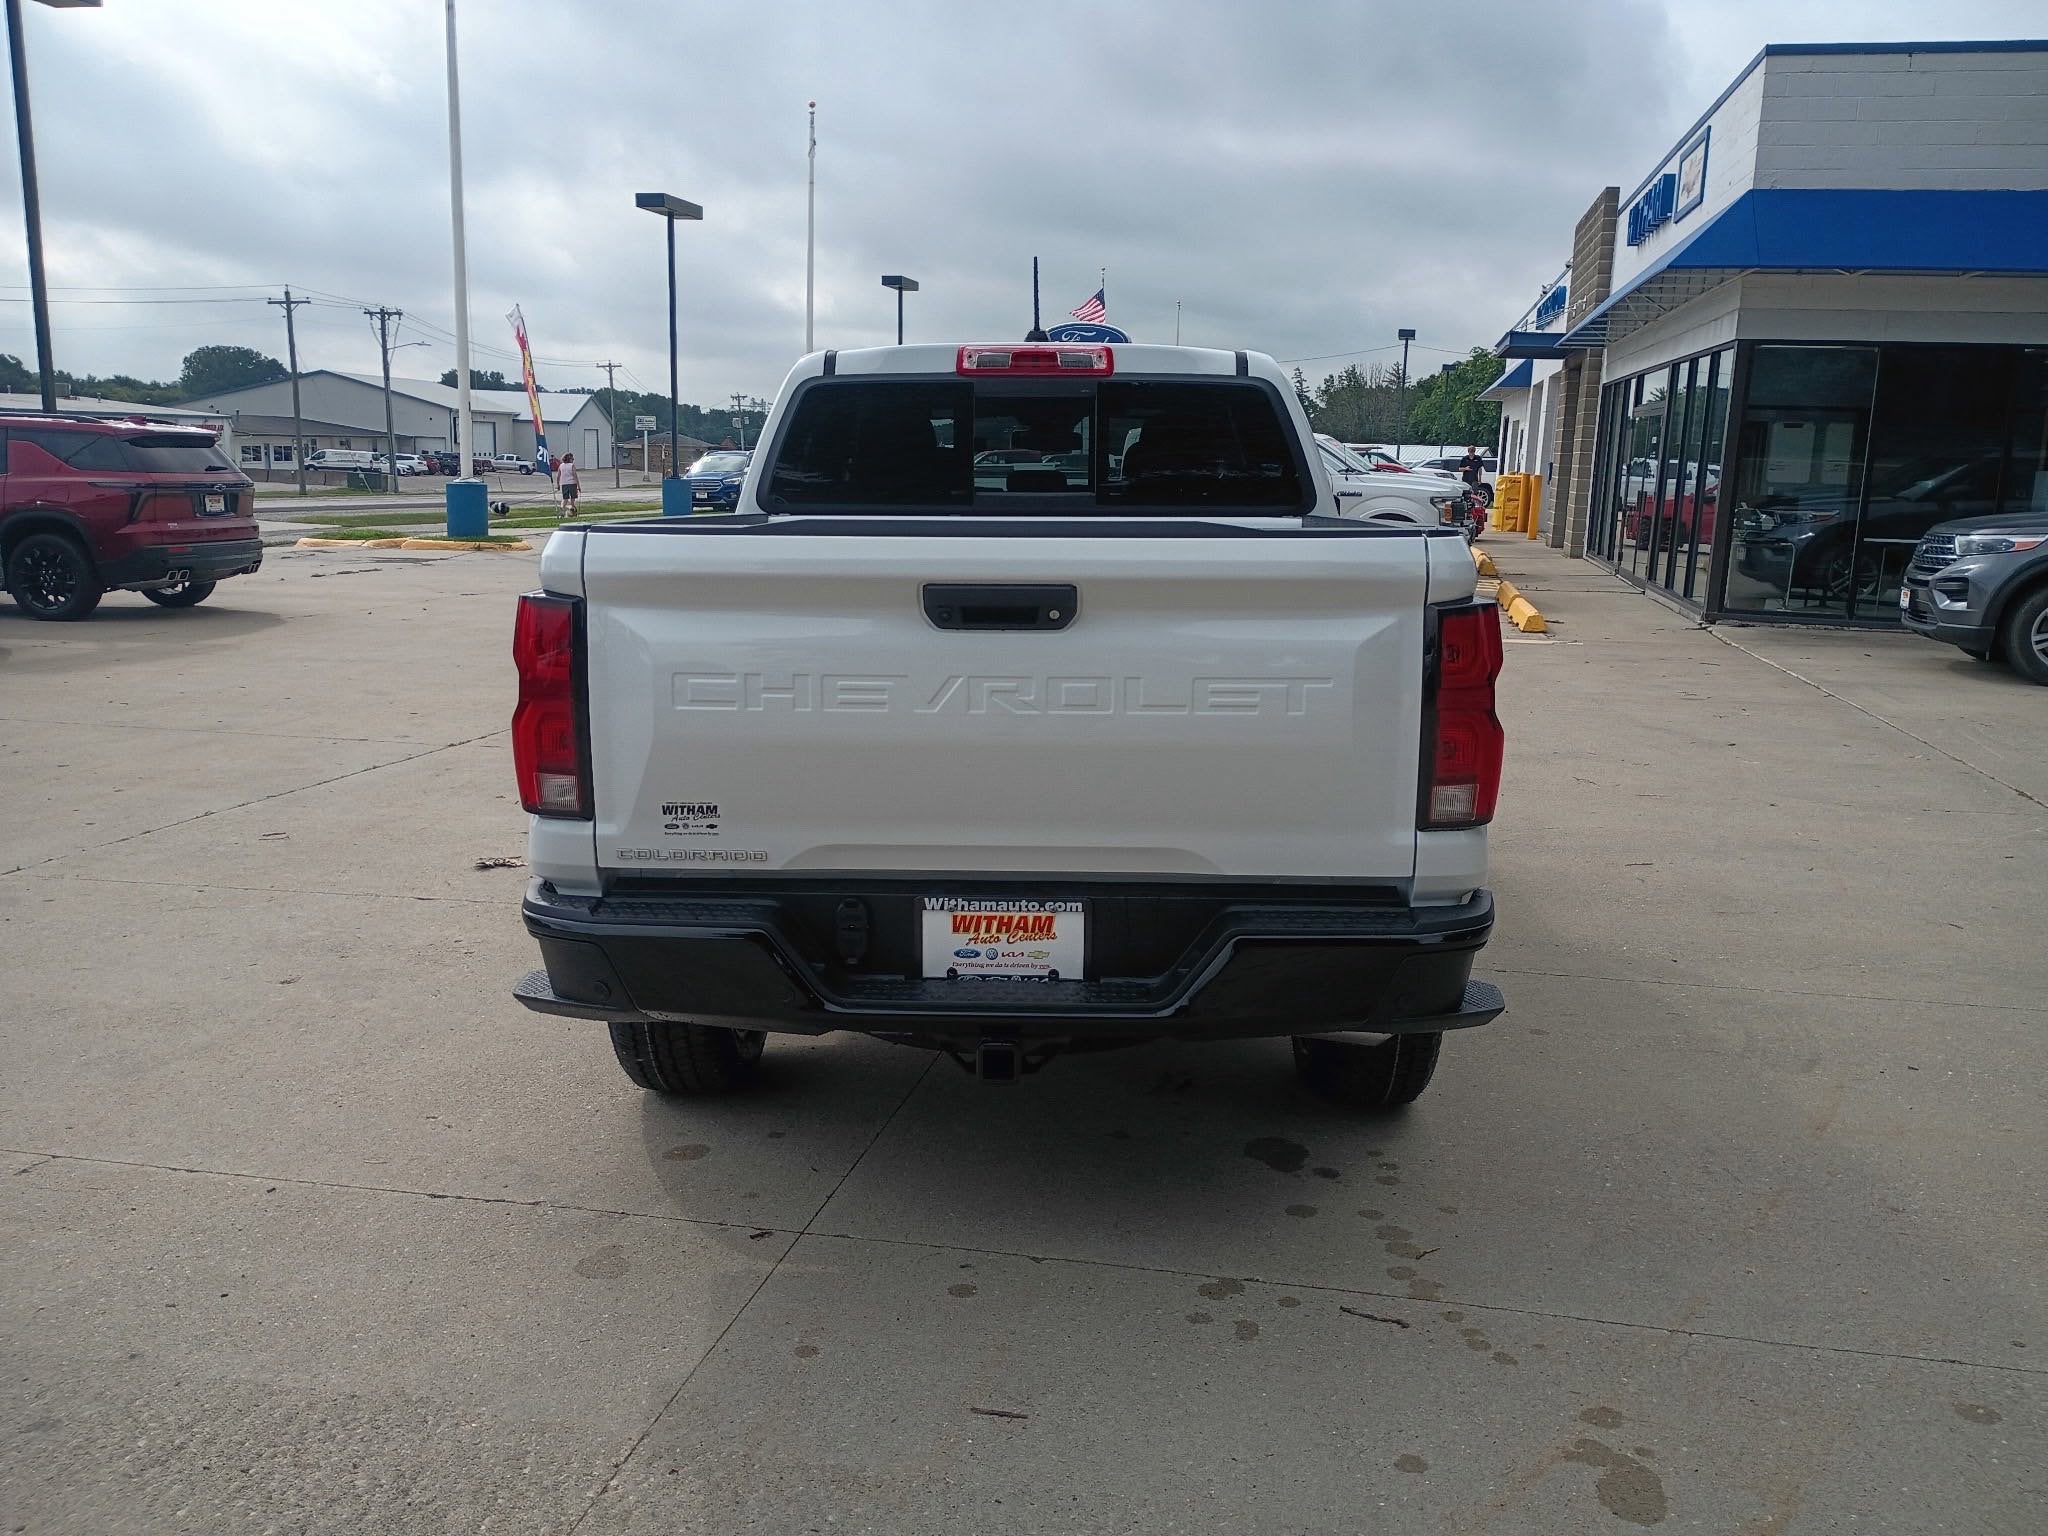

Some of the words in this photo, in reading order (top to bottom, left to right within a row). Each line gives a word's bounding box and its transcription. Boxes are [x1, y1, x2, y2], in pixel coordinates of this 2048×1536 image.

[671, 672, 1333, 716] CHEVROLET
[661, 804, 718, 816] WITHAM
[671, 814, 690, 822] Auto
[693, 812, 721, 821] Centers
[616, 847, 768, 862] COLORADO
[924, 897, 1083, 912] Withamauto.com
[952, 913, 1056, 934] WITHAM
[966, 933, 1001, 946] Auto
[1006, 930, 1058, 945] Centers
